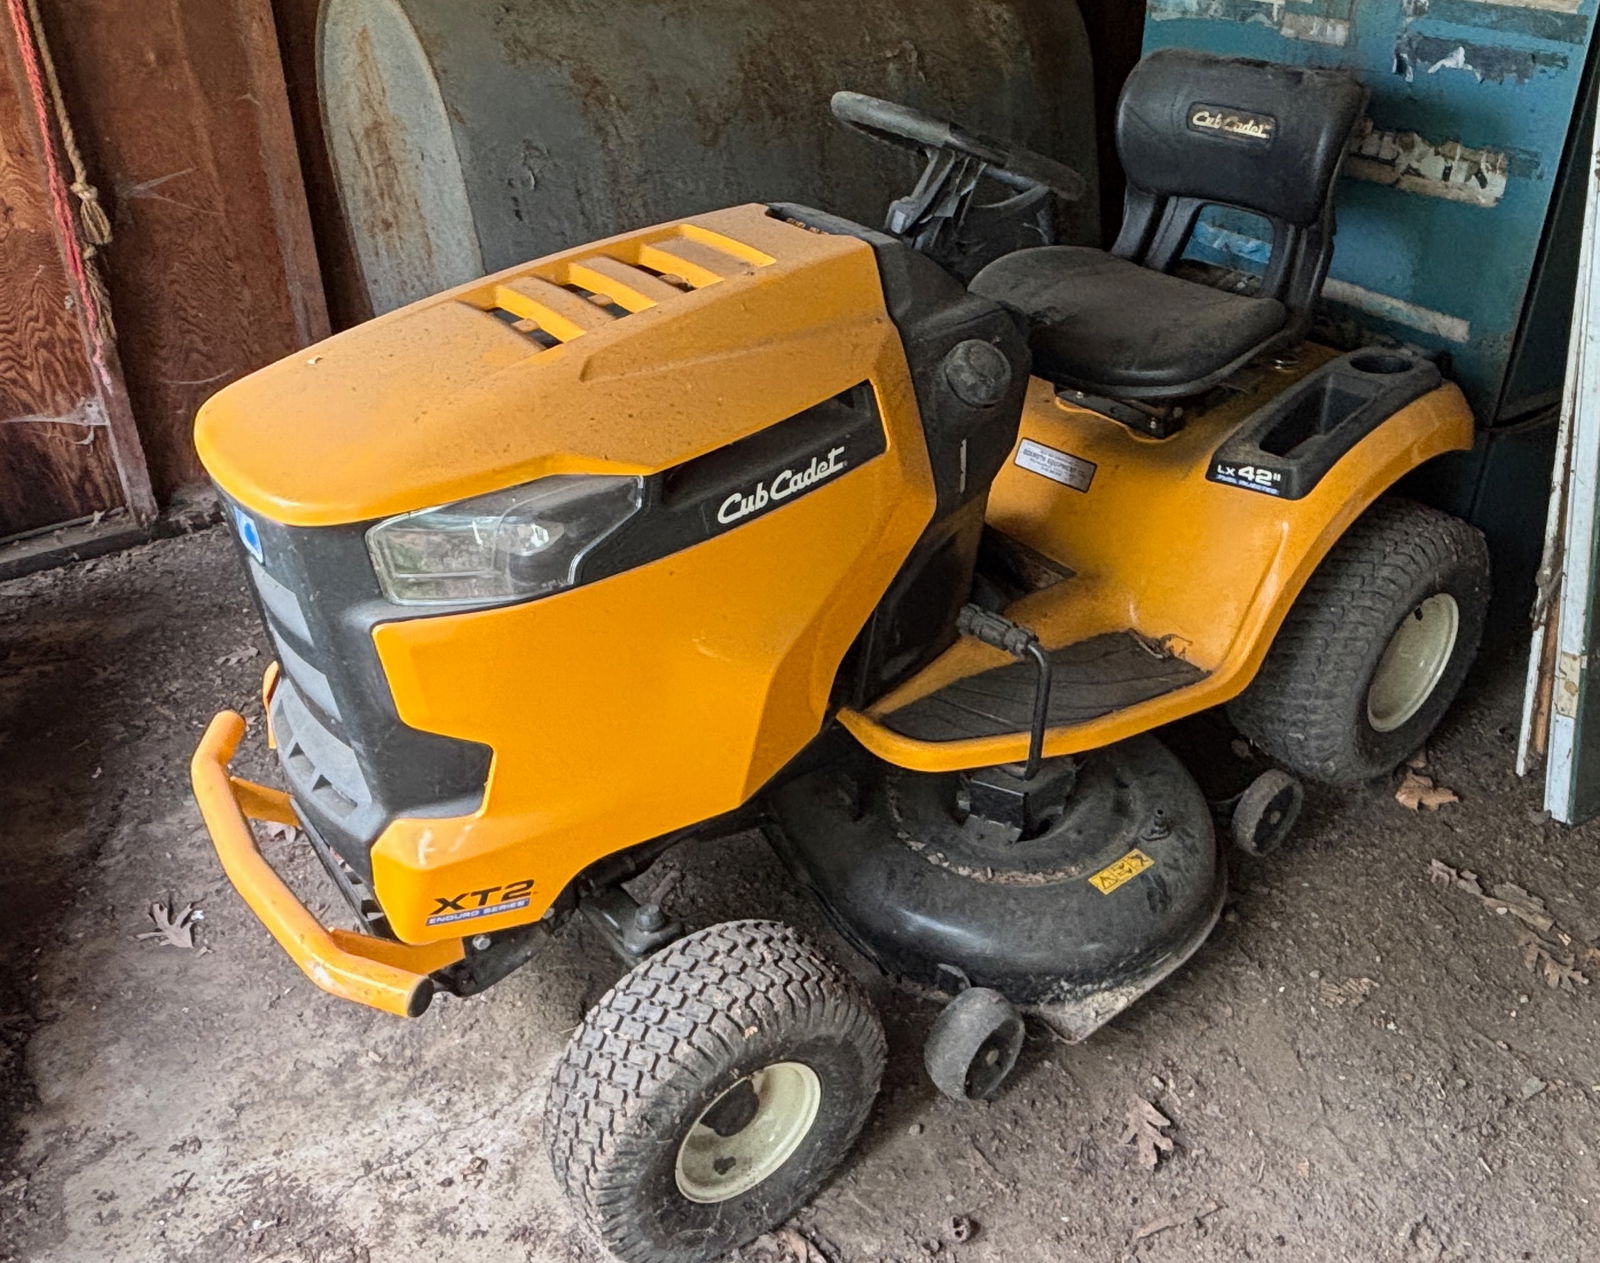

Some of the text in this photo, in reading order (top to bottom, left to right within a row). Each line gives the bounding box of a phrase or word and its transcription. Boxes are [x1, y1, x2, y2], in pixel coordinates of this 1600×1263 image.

[1192, 111, 1271, 139] Cub Cadet
[1217, 464, 1236, 477] LX
[717, 446, 845, 524] Cub Cadet
[429, 879, 535, 916] XT2
[428, 899, 527, 925] ENDURO SERIES
